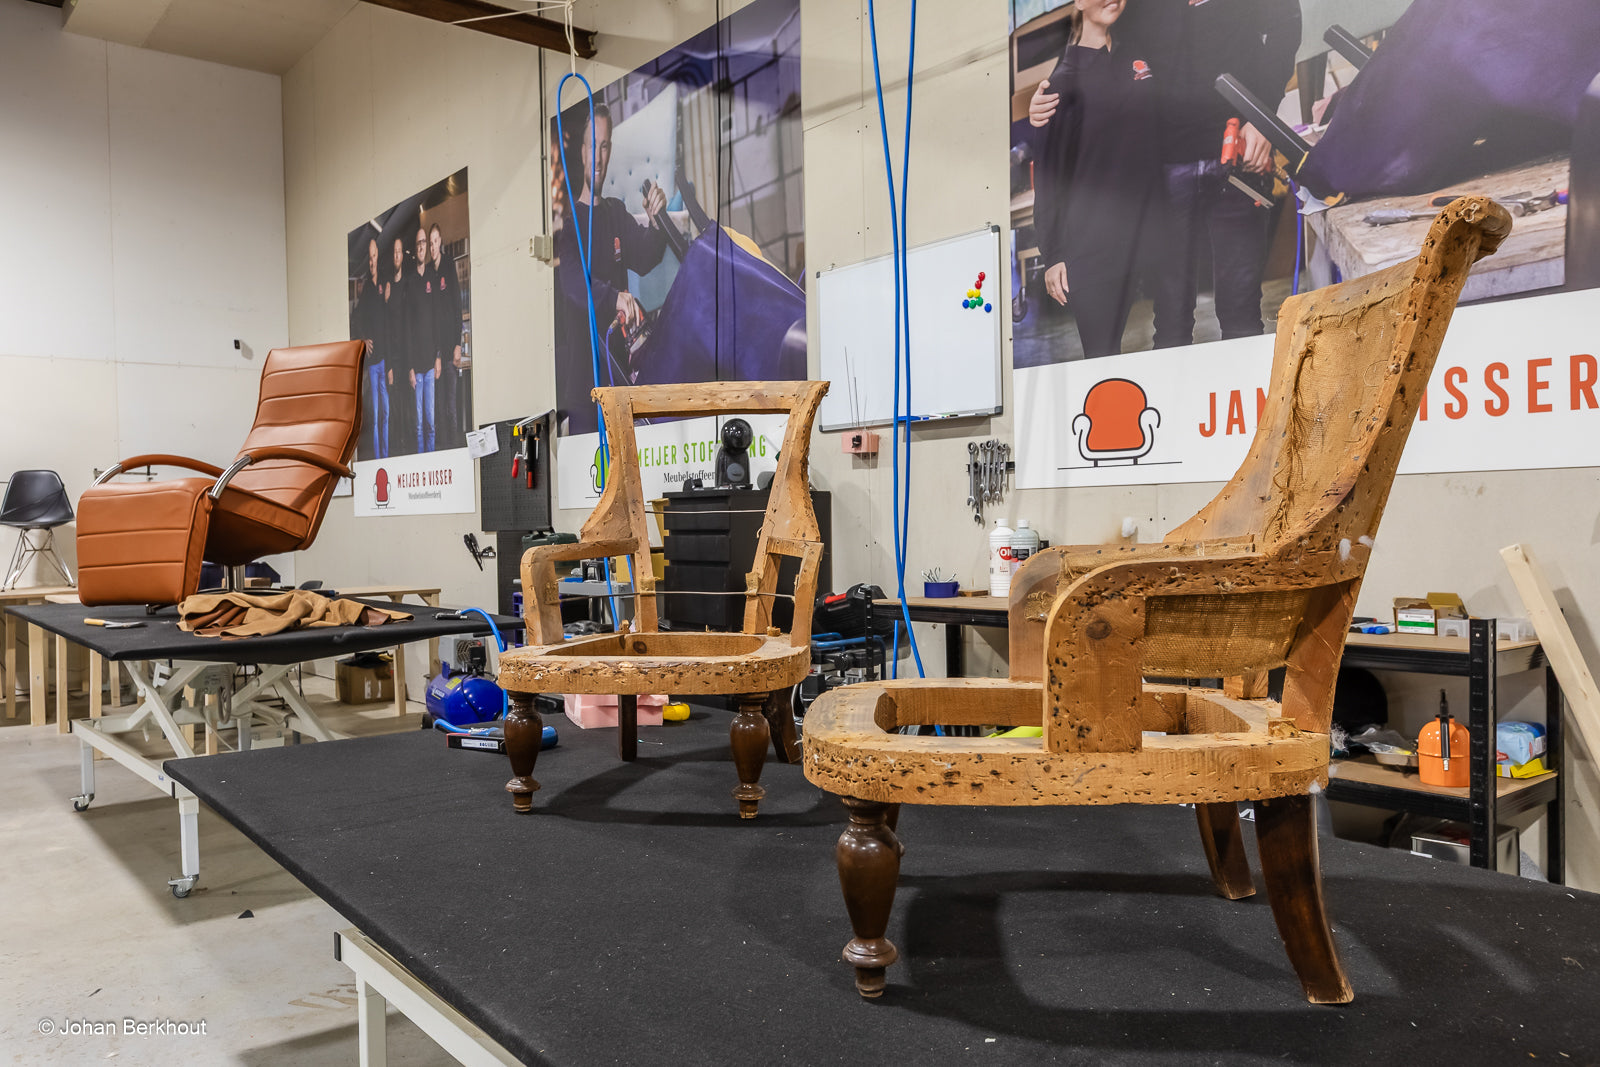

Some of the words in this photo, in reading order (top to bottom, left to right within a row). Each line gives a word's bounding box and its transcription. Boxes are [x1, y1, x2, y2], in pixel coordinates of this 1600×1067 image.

[1419, 354, 1600, 421] ISSER
[683, 434, 766, 464] STOFNG
[397, 472, 419, 488] MEIJER
[428, 468, 452, 486] VISSER
